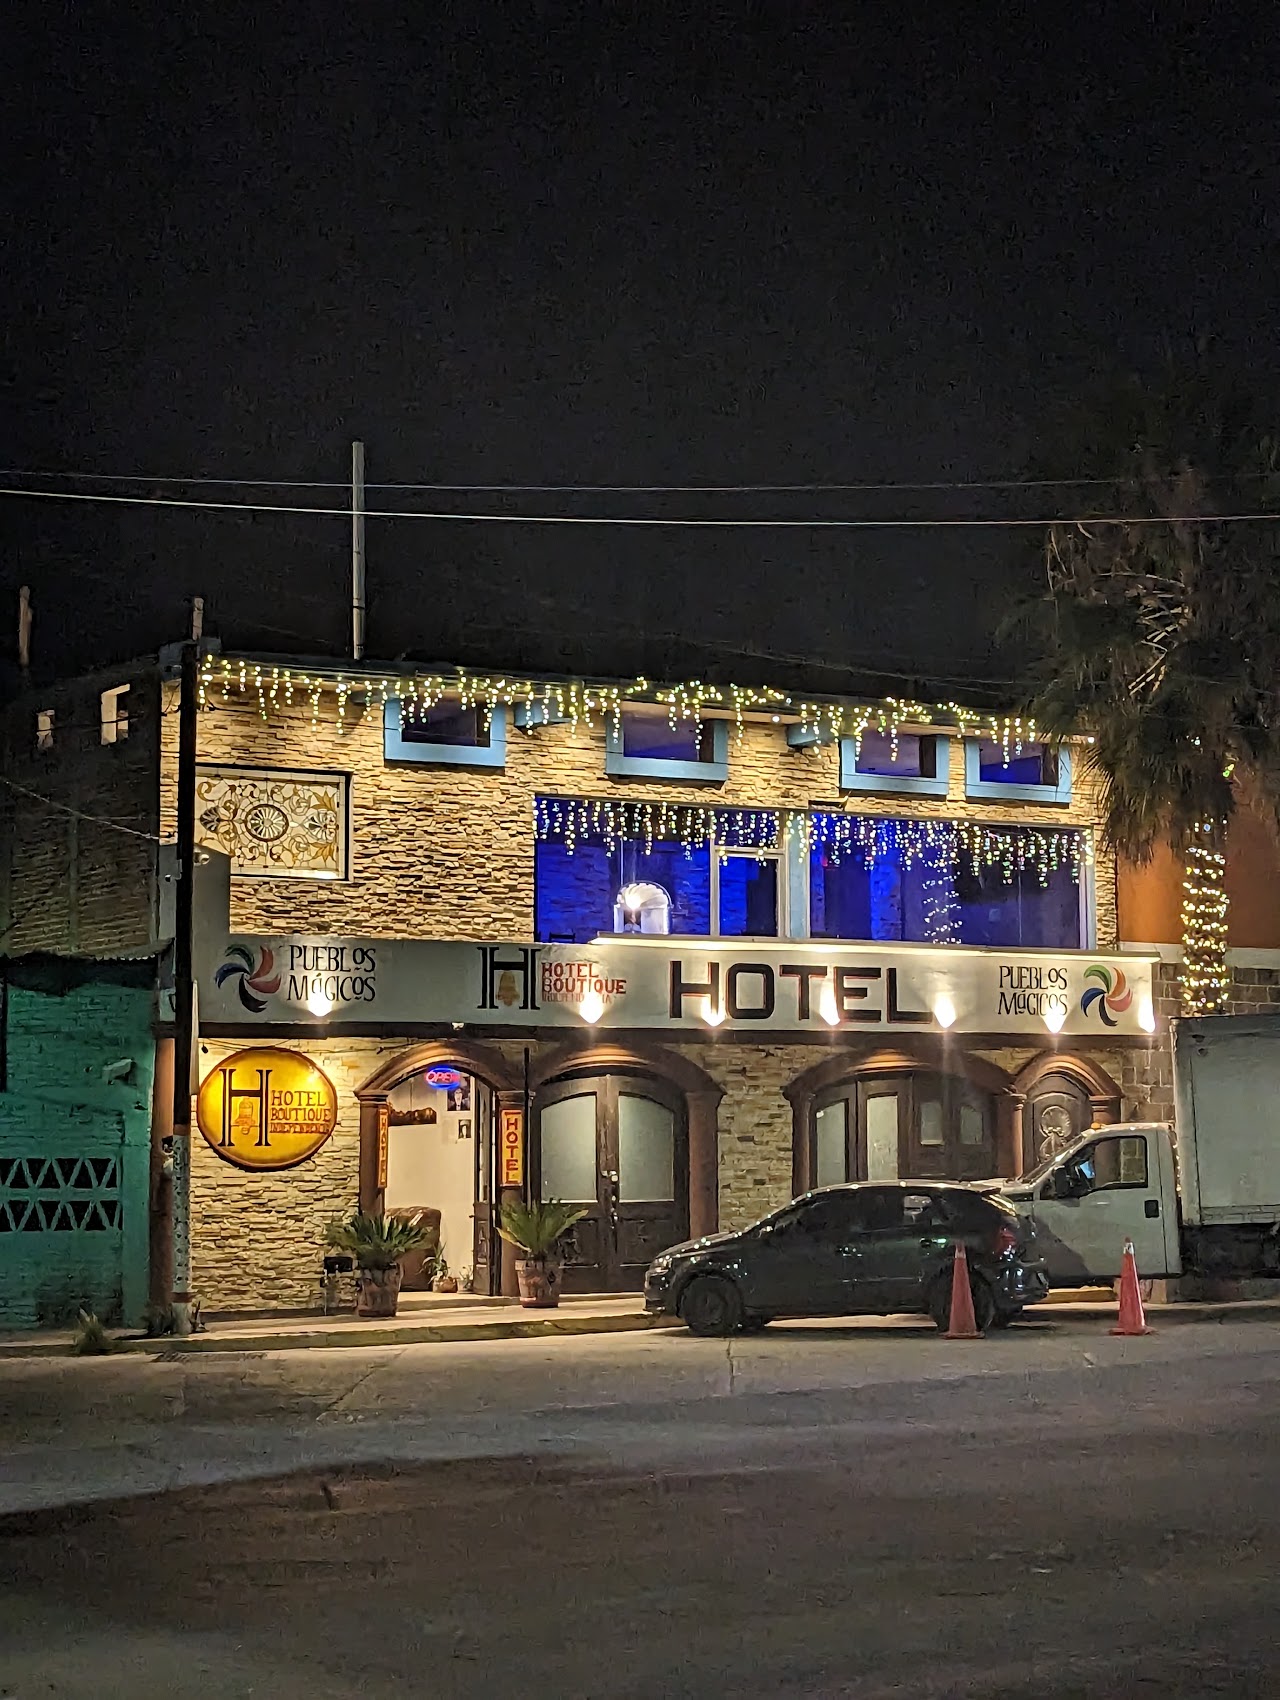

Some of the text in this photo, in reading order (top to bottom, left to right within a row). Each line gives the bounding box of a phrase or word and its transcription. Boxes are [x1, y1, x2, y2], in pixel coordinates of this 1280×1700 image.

[541, 962, 599, 978] HOTEL
[541, 977, 627, 994] BOUTIQUE
[669, 960, 933, 1024] HOTEL
[271, 1090, 327, 1106] HOTEL
[270, 1107, 331, 1122] BOUTIQUE
[506, 1118, 519, 1185] HOTEL
